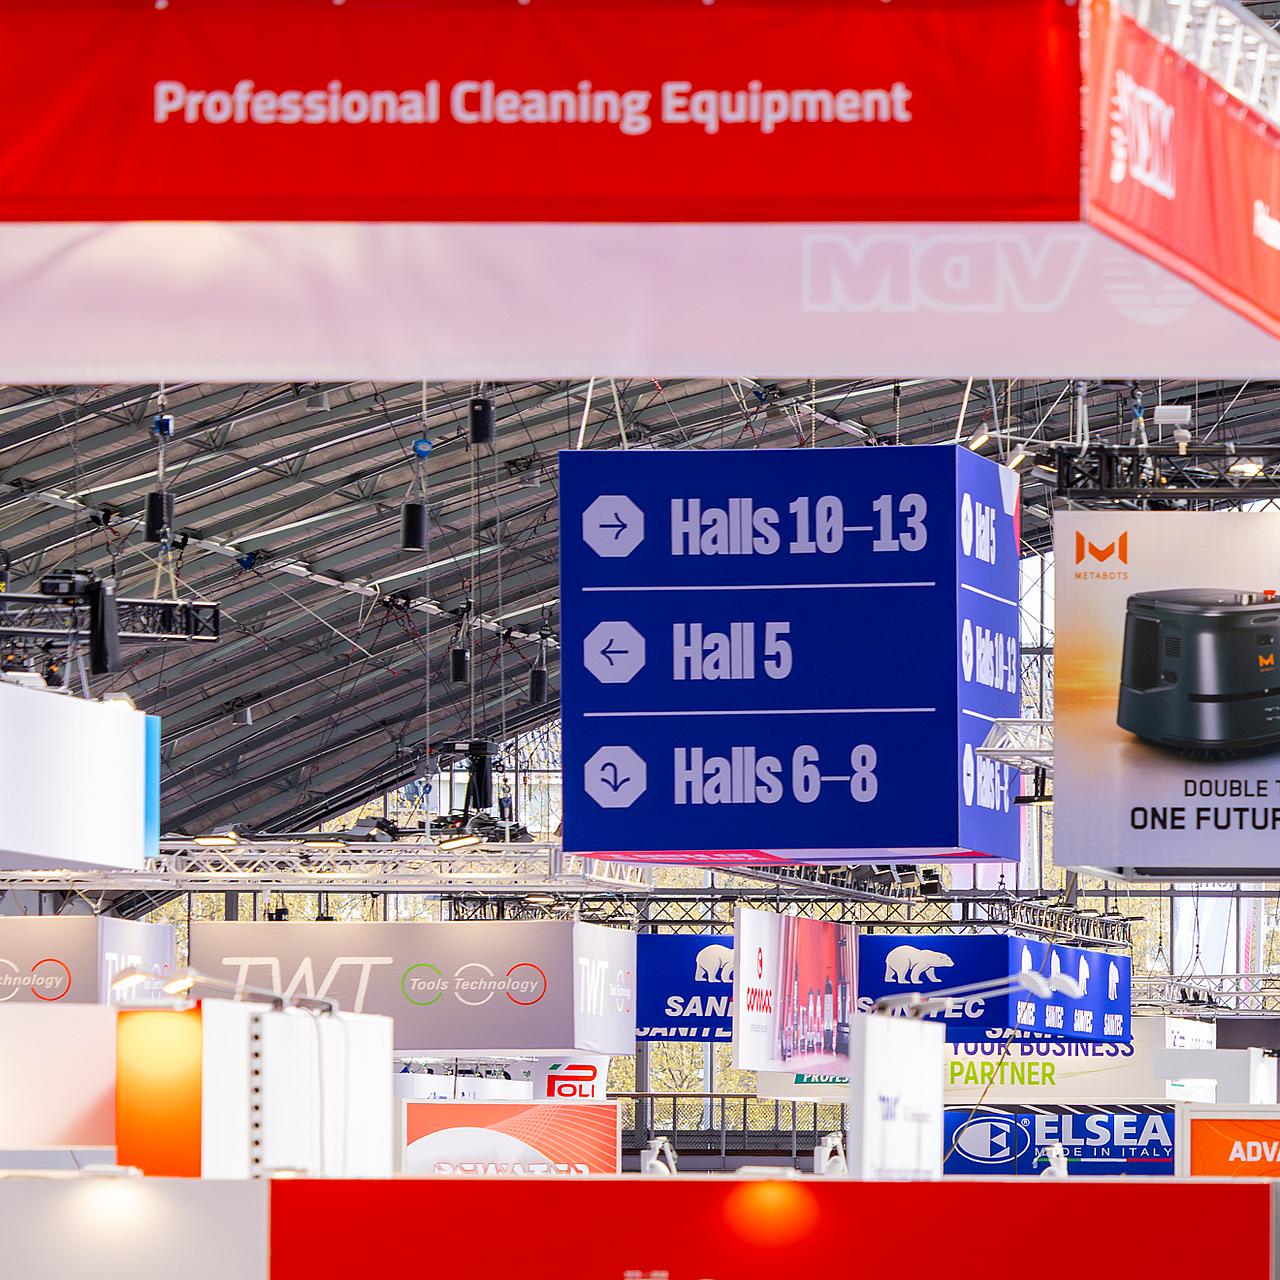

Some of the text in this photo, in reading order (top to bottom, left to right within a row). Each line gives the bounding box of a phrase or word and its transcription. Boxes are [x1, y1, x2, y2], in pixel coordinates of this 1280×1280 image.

[154, 79, 912, 135] Professional Cleaning Equipment
[670, 497, 782, 555] Halls
[1075, 571, 1128, 580] METABOTS
[672, 621, 793, 680] Hall 5
[673, 746, 784, 804] Halls
[1184, 779, 1270, 798] DOUBLE
[1130, 807, 1190, 830] ONE
[410, 977, 539, 993] Tools Technology
[579, 957, 609, 1016] TWT
[1020, 1037, 1135, 1057] BUSINESS
[949, 1061, 1056, 1086] PARTNER
[1034, 1114, 1173, 1147] ELSEA
[1094, 1147, 1110, 1157] IN
[1121, 1147, 1174, 1158] ITALY
